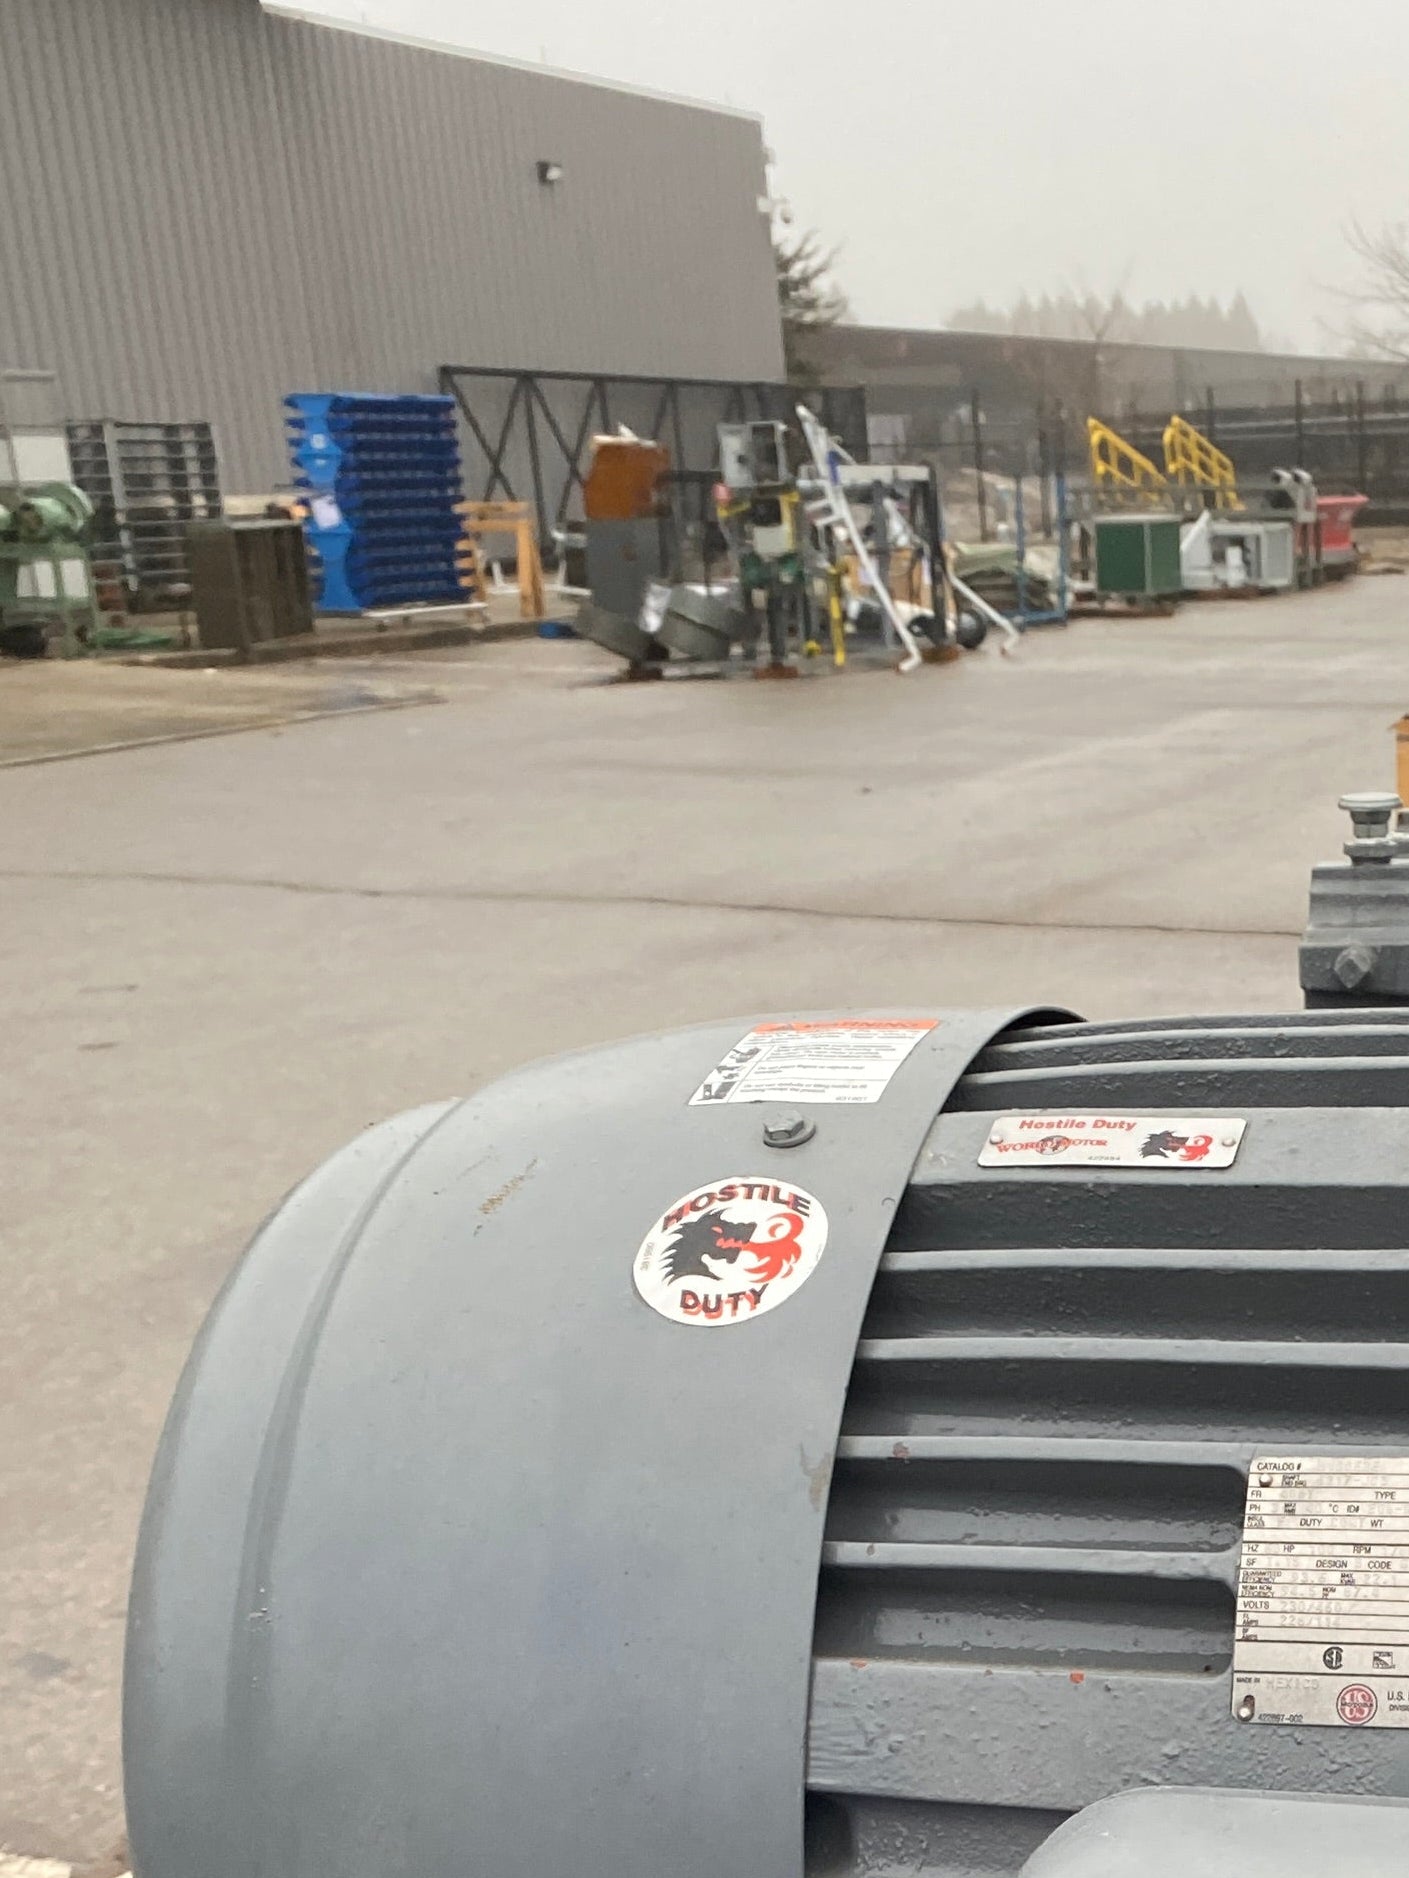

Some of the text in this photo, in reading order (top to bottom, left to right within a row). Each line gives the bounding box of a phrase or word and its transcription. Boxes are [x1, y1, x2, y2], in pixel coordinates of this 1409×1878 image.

[1019, 1120, 1136, 1131] Hostile Duty
[662, 1183, 810, 1233] HOSTILE
[680, 1283, 769, 1319] DUTY
[1257, 1463, 1294, 1471] CATALOG
[1251, 1490, 1262, 1498] FR
[1375, 1491, 1396, 1499] TYPE
[1316, 1560, 1348, 1568] DESIGN
[1368, 1561, 1392, 1569] CODE
[1243, 1601, 1269, 1609] VOLTS
[1387, 1692, 1405, 1700] U.S.
